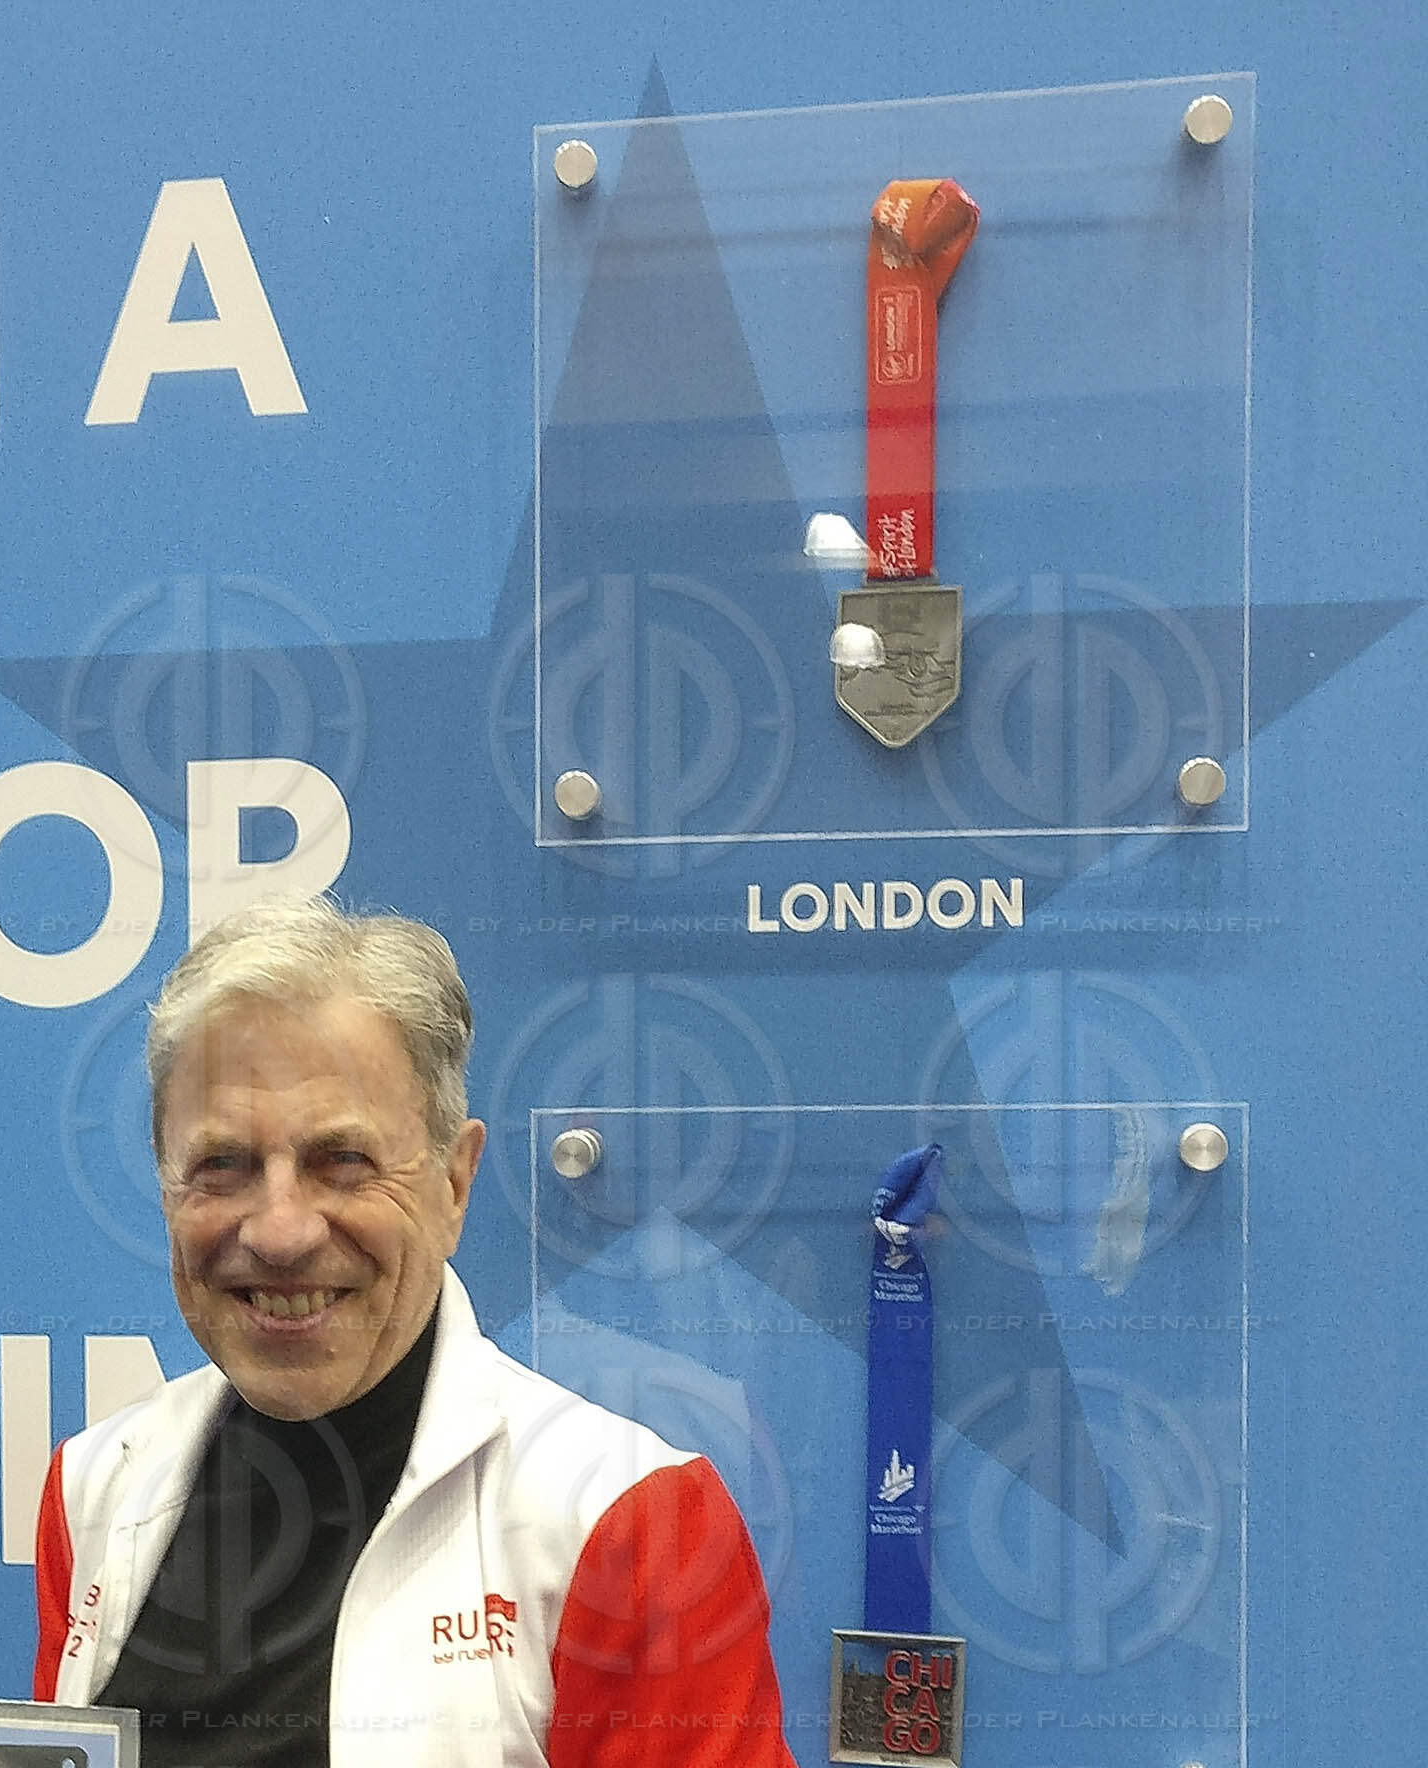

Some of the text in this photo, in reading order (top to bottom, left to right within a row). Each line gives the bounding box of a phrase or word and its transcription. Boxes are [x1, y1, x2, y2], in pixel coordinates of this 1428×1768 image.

[84, 177, 309, 427] A
[747, 878, 1023, 933] LONDON
[884, 1650, 953, 1689] CHI
[883, 1683, 940, 1722] CA
[882, 1719, 941, 1754] GO
